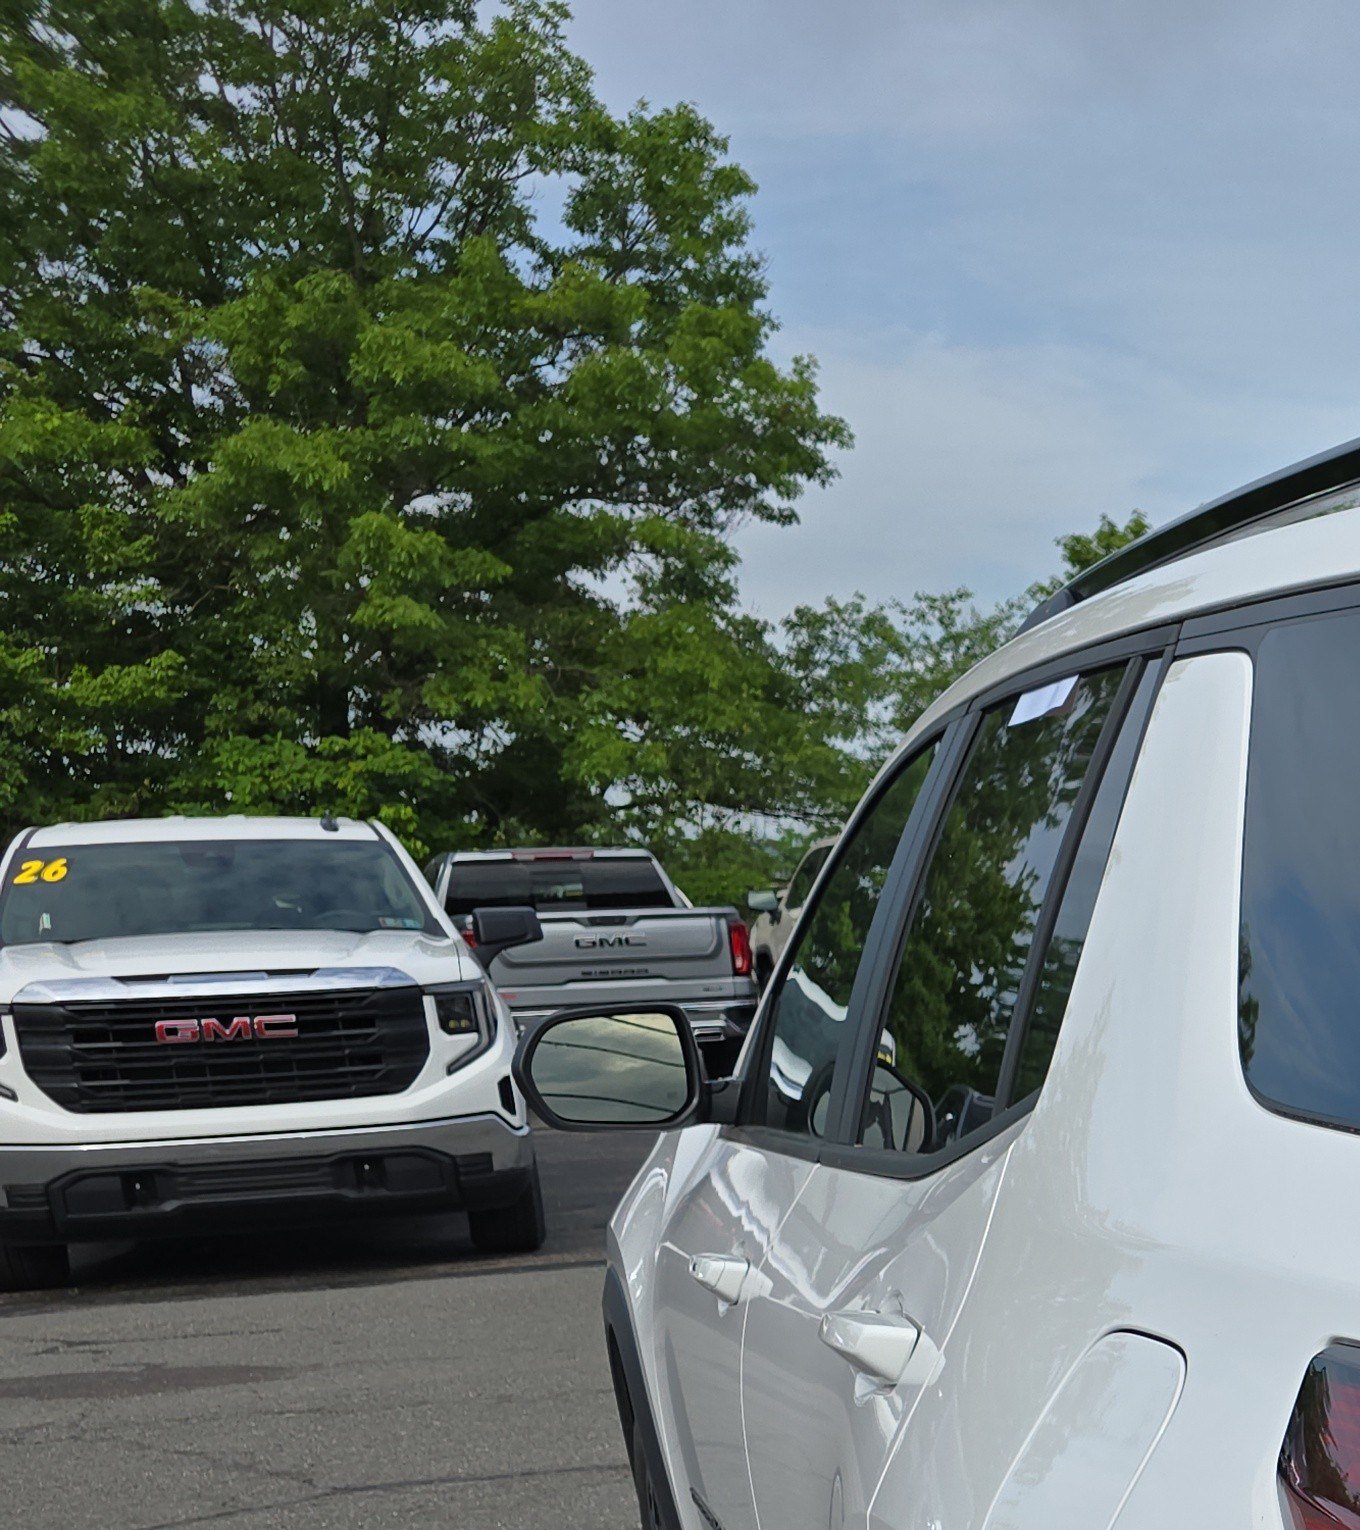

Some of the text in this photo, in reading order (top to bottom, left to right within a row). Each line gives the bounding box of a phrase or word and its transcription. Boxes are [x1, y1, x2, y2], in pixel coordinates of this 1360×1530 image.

[13, 857, 68, 885] 26
[574, 932, 648, 950] GMC
[155, 1014, 299, 1044] GMC
